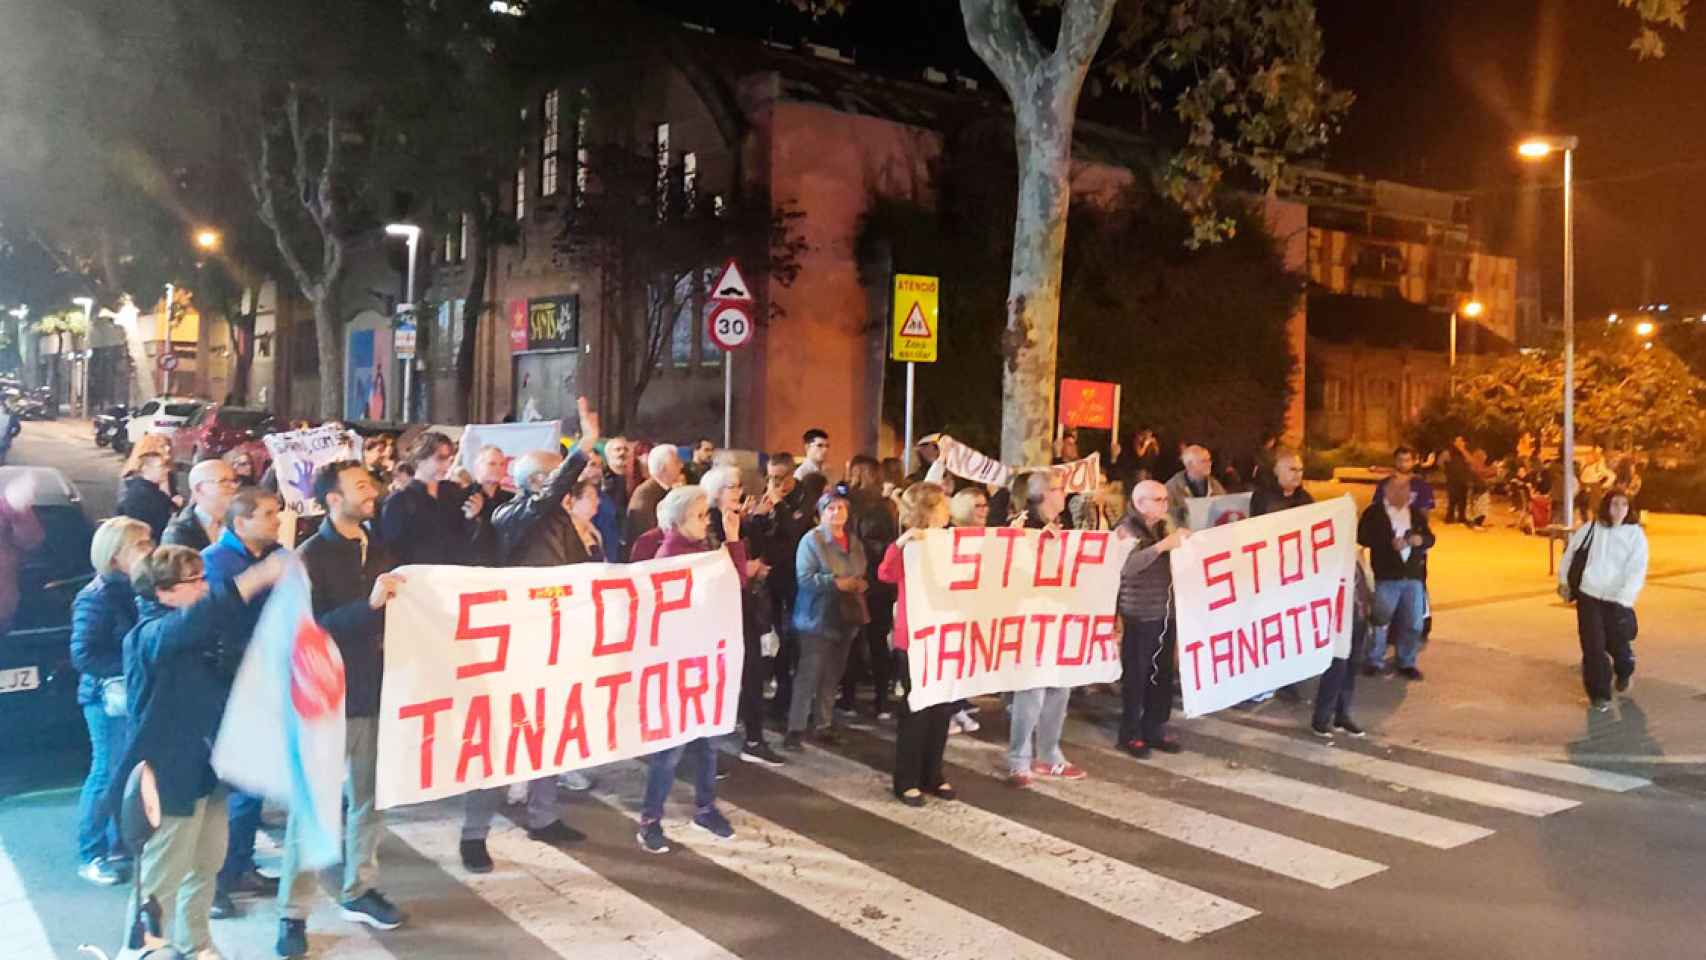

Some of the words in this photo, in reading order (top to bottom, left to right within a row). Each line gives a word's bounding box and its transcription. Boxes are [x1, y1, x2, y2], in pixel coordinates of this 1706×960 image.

[719, 318, 744, 335] 30
[949, 527, 1109, 590] STOP
[1203, 519, 1336, 611] STOP
[455, 568, 692, 680] STOP
[914, 614, 1117, 688] TANATOR
[1185, 578, 1346, 690] TANATOI
[399, 639, 725, 789] TANATORI
